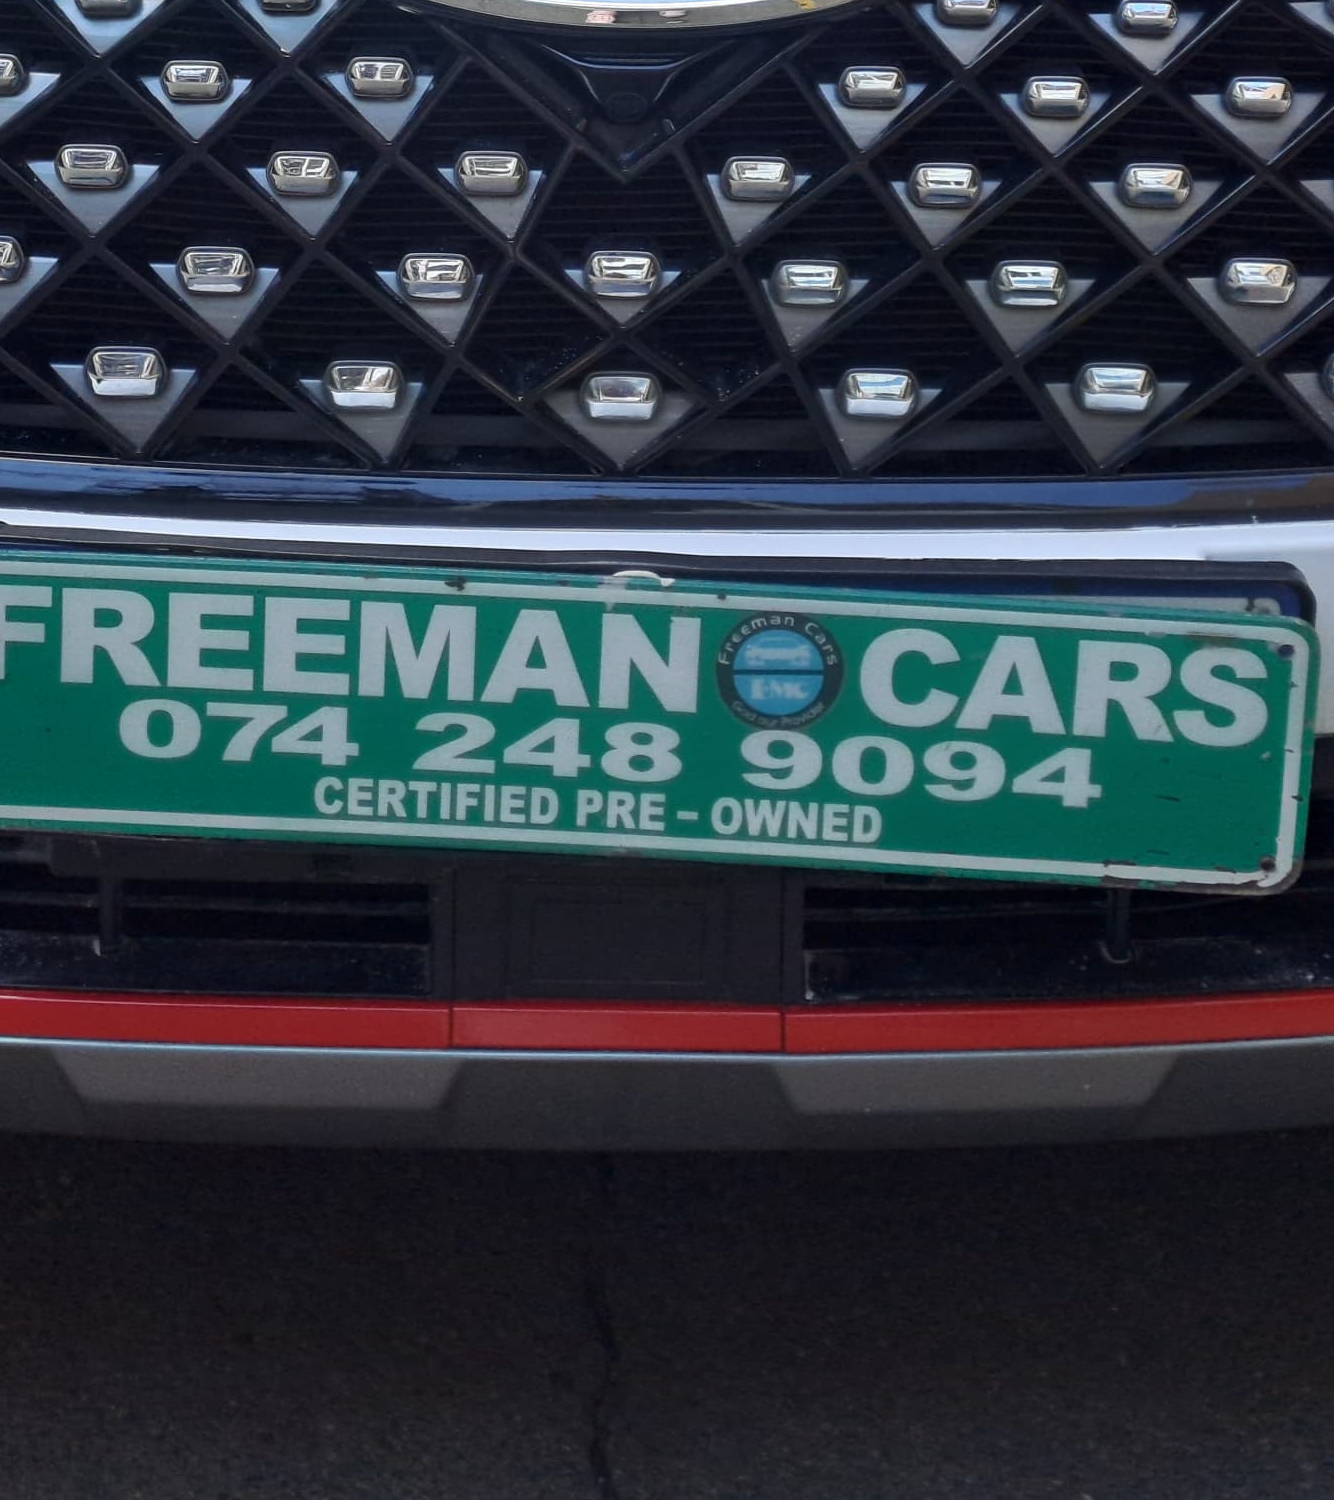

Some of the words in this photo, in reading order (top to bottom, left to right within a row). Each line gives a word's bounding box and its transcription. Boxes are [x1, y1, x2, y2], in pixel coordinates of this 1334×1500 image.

[718, 614, 796, 666] Freeman
[804, 621, 838, 666] Cars
[859, 627, 1269, 748] CARS
[118, 698, 360, 766] 074
[411, 711, 683, 783] 248
[739, 729, 1103, 808] 9094
[313, 775, 560, 827] CERTIFIED
[575, 788, 666, 832] PRE
[711, 797, 884, 844] OWNED
